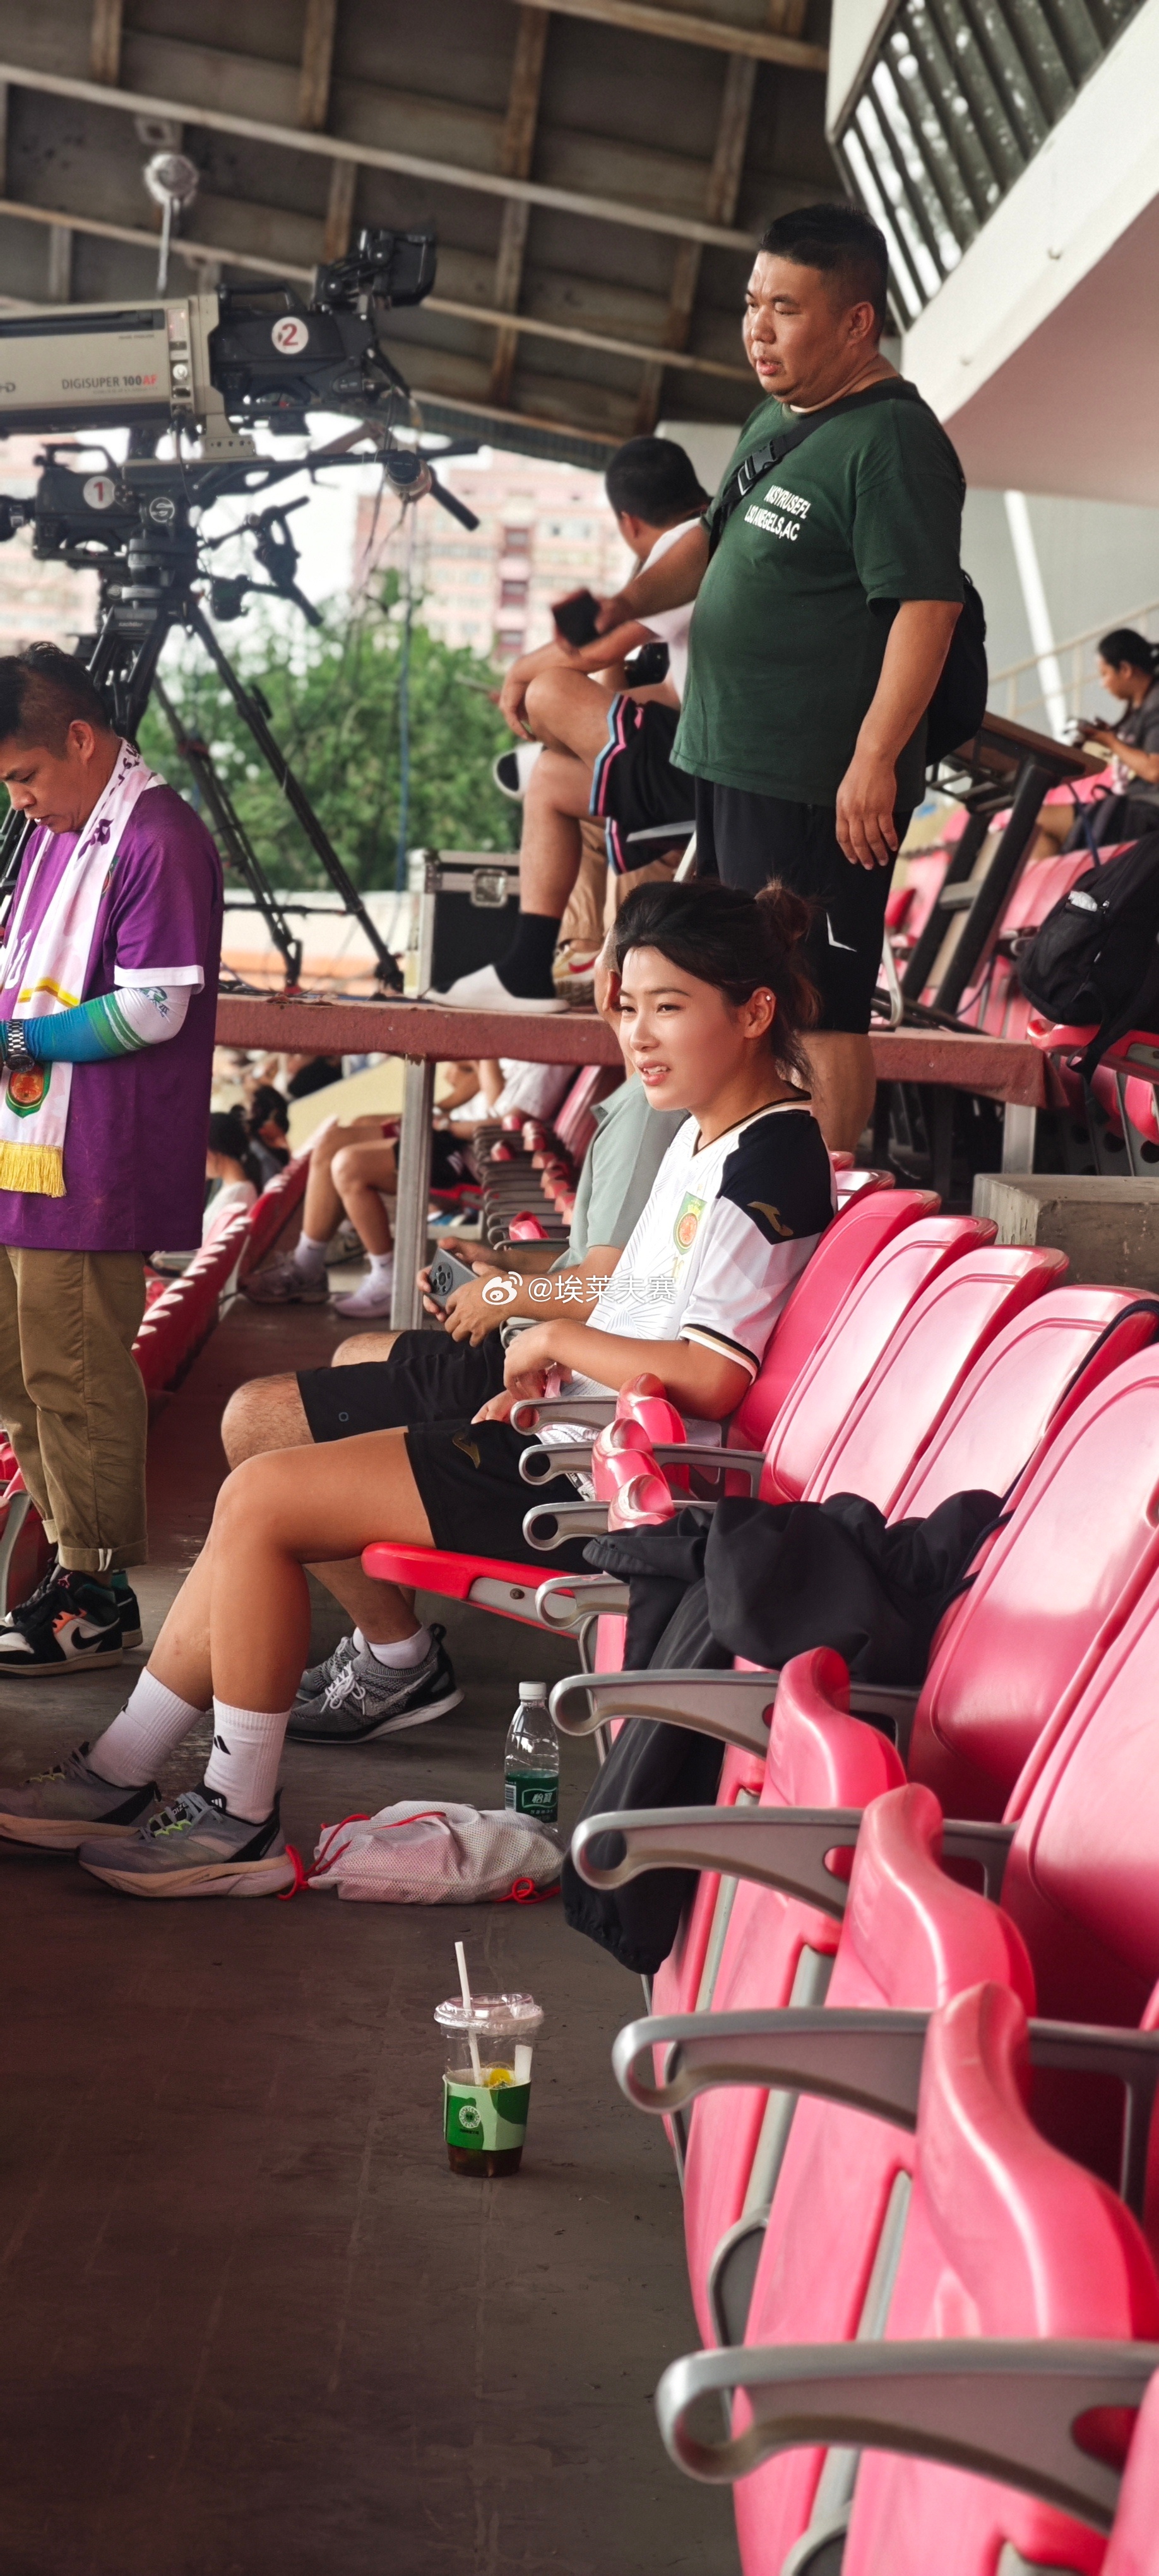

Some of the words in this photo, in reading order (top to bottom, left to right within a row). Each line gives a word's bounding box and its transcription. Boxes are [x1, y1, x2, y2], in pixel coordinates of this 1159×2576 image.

[282, 323, 299, 346] 2
[61, 376, 119, 390] DIGISUPER
[123, 374, 157, 386] 100AF
[93, 482, 104, 502] 1
